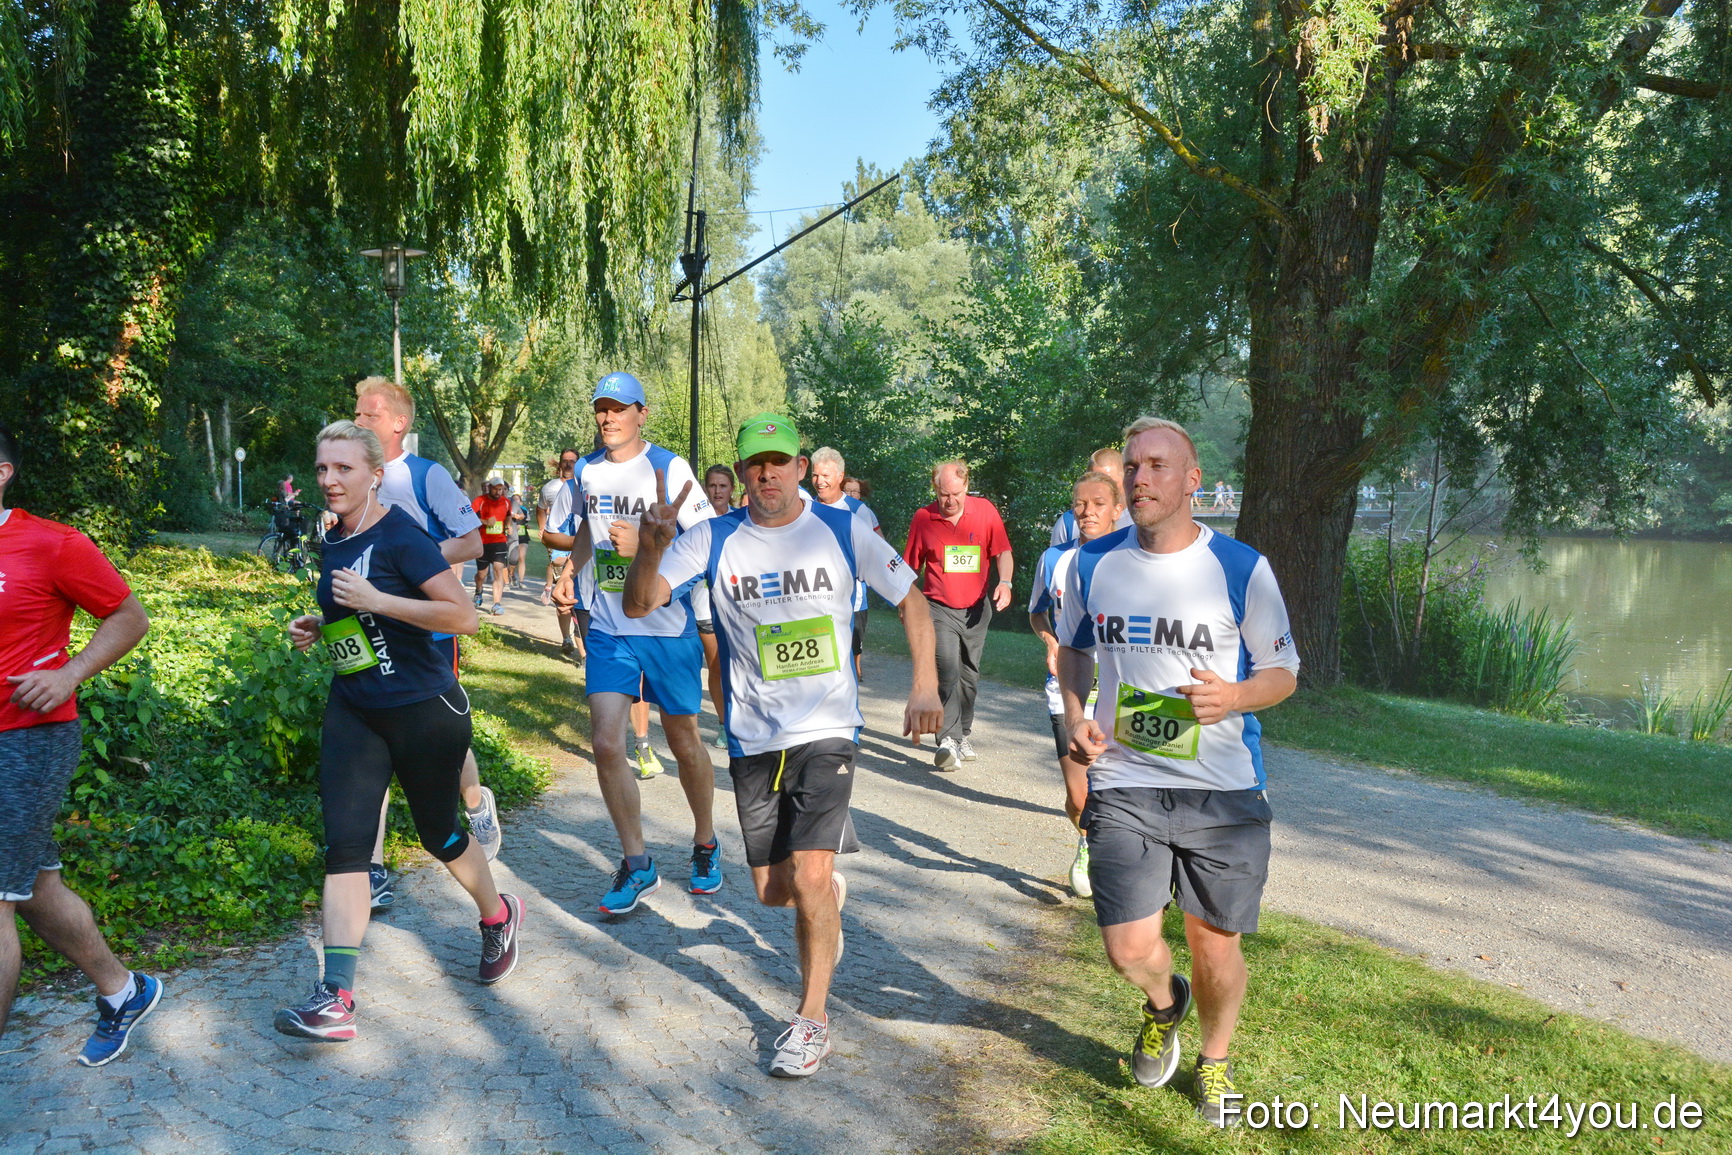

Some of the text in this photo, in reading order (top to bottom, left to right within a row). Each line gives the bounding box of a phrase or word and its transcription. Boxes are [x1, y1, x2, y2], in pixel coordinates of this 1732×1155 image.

[952, 555, 973, 565] 367
[730, 567, 833, 602] iREMA
[765, 596, 792, 606] FILTER
[795, 594, 834, 602] Technology
[1097, 613, 1214, 652] iREMA
[327, 637, 361, 661] 608
[371, 629, 396, 676] RAIL
[775, 638, 820, 663] 828
[1130, 646, 1163, 654] FILTER
[1167, 648, 1214, 661] Technology
[799, 658, 825, 667] Andreas
[1130, 711, 1179, 741] 830
[1124, 729, 1184, 749] Reuthlinger Daniel
